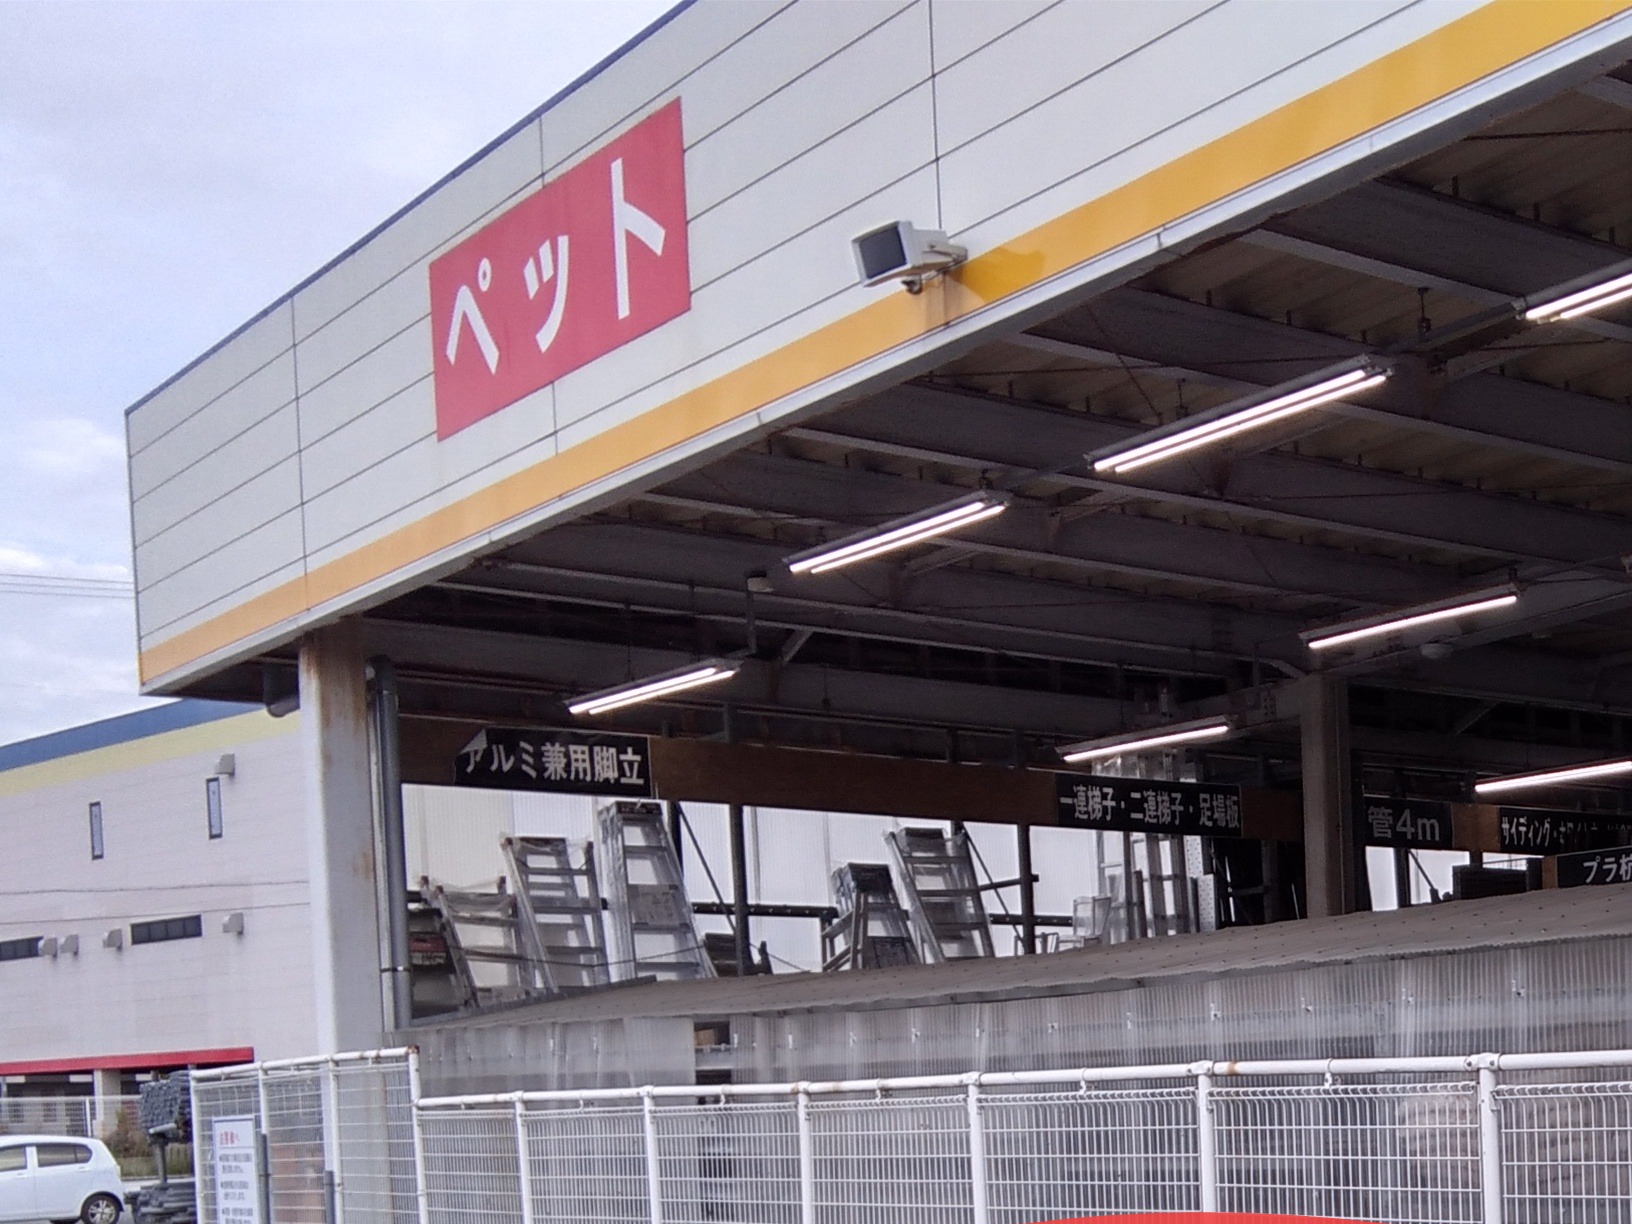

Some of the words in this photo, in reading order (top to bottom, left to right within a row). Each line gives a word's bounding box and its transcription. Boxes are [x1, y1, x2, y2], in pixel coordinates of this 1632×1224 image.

[446, 157, 666, 375] ペット
[461, 740, 646, 786] アルミ兼用脚立
